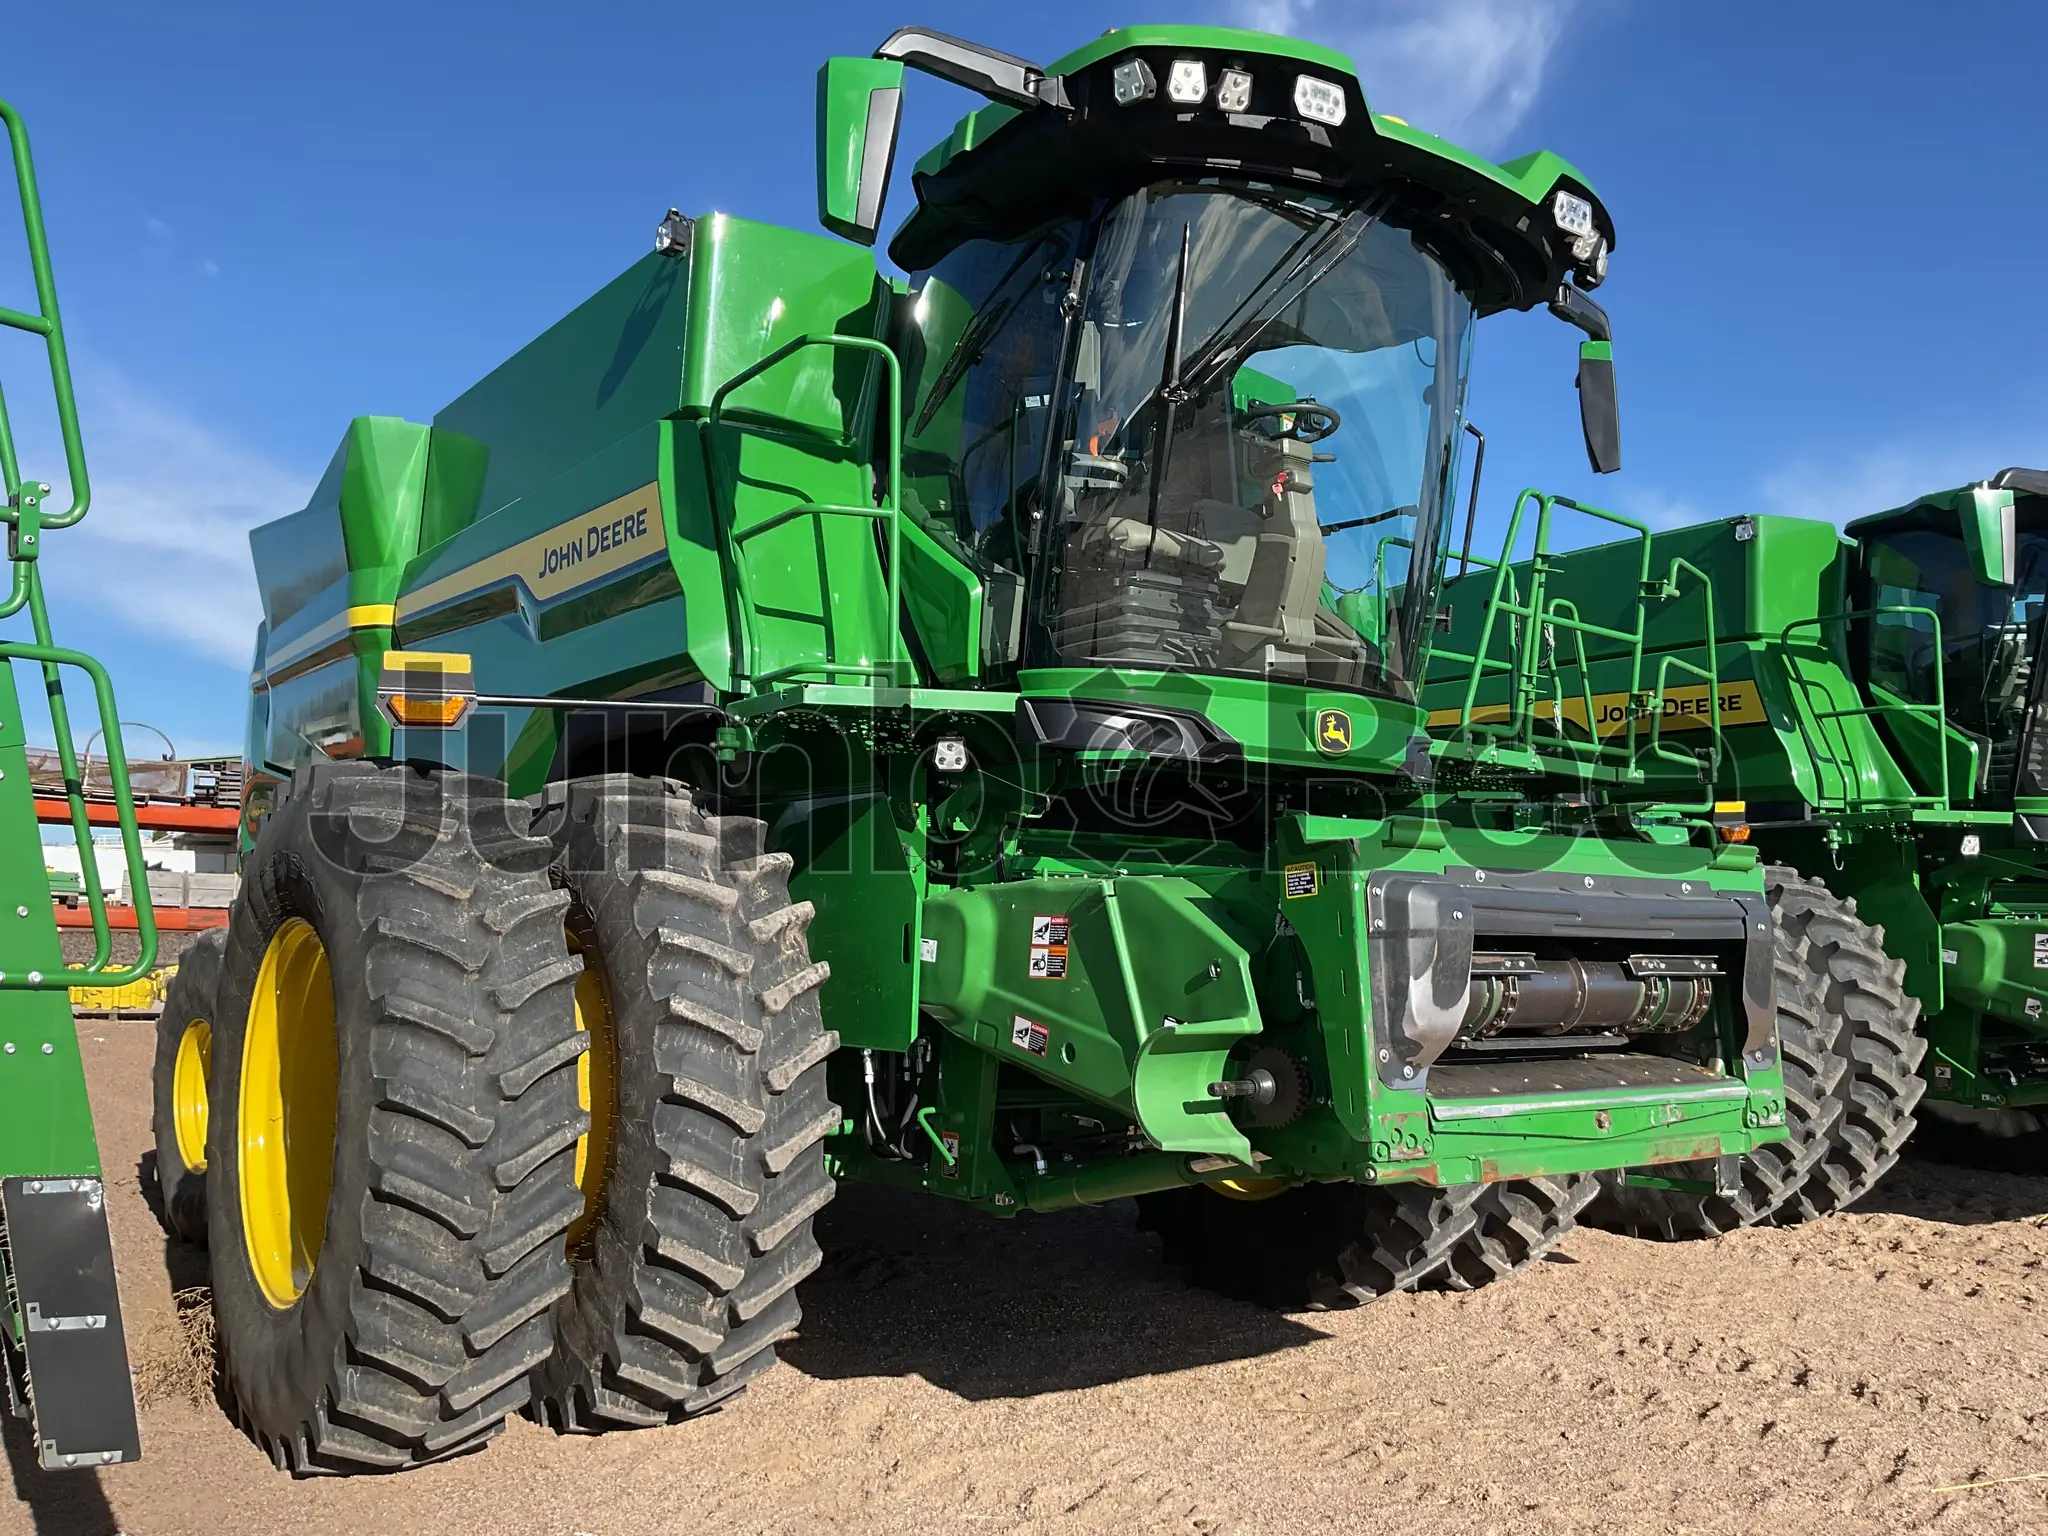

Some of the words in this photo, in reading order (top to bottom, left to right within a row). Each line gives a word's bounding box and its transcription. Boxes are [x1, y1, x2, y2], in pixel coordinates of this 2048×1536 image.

[538, 537, 583, 579] JOHN
[587, 507, 648, 559] DEERE
[1597, 703, 1652, 723] JO
[1662, 694, 1742, 718] DEERE
